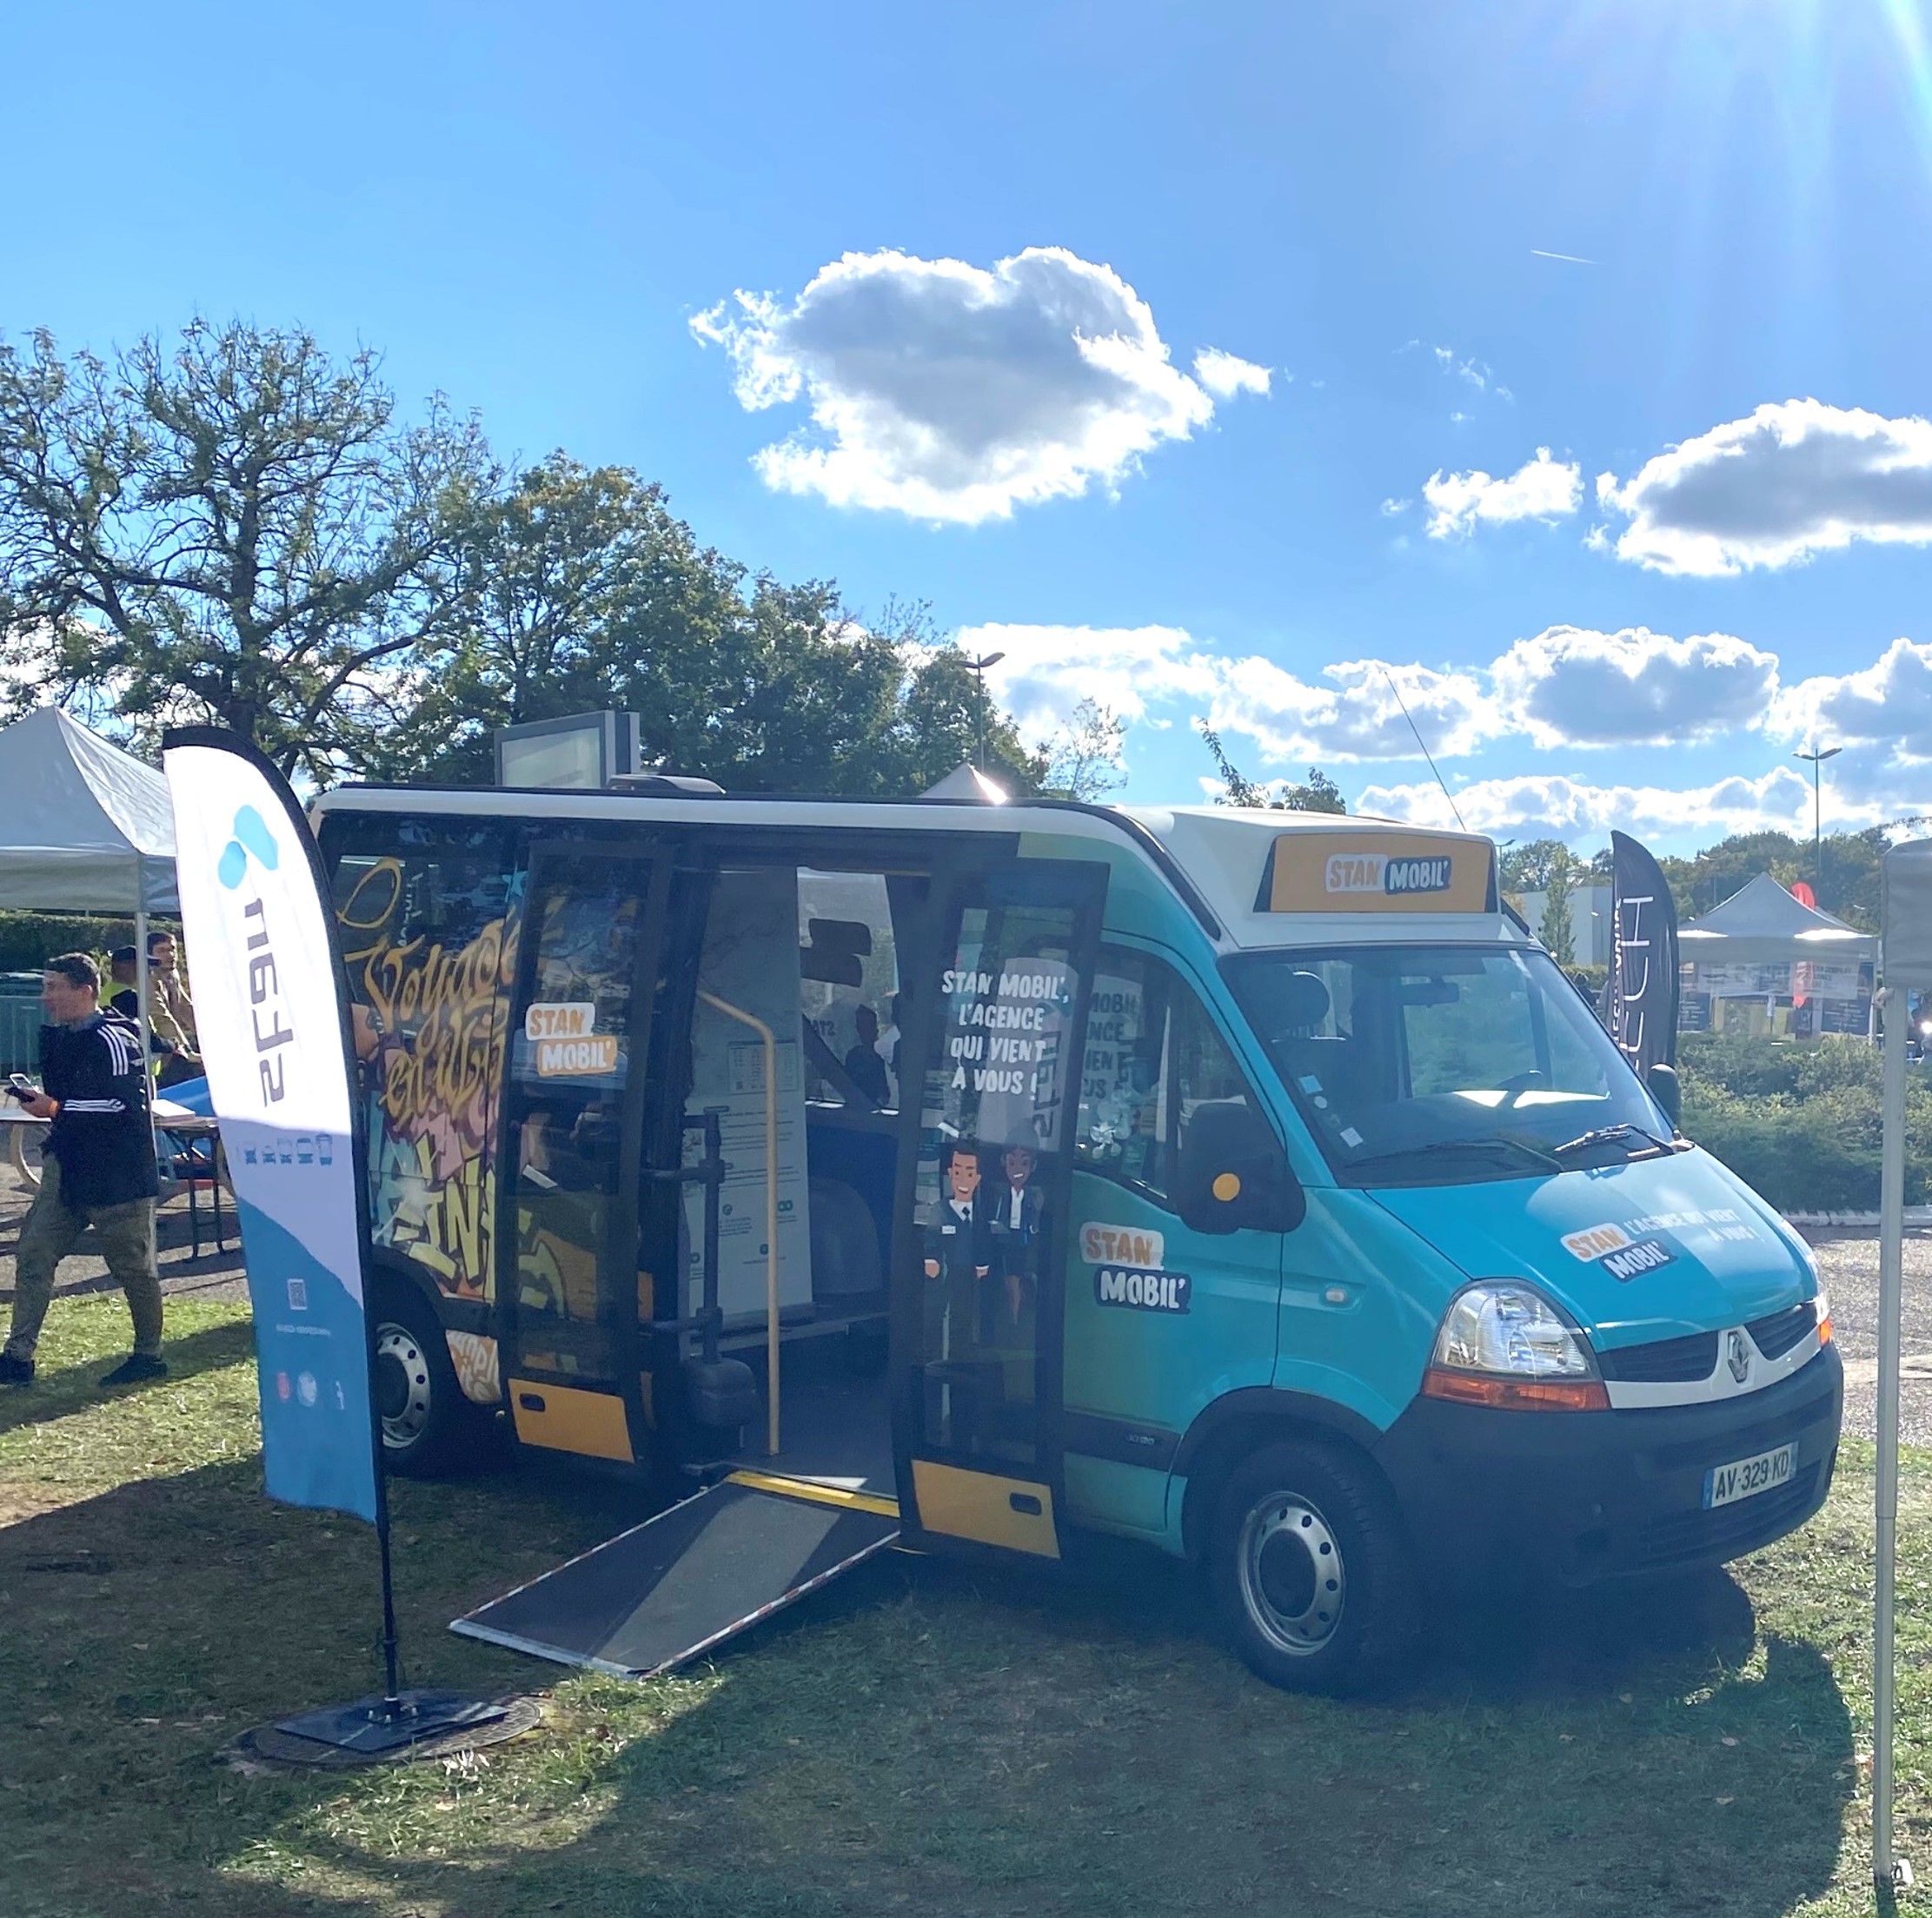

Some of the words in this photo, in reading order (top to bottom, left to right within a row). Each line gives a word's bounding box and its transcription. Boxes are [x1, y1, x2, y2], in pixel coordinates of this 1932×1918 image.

[1330, 860, 1382, 887] STAN
[1389, 859, 1449, 892] MOBIL'
[941, 970, 994, 995] STAN
[529, 1008, 585, 1036] STAN
[958, 1003, 1046, 1032] L'AGENCE
[541, 1039, 612, 1072] MOBIL'
[950, 1035, 983, 1064] QUI
[989, 1037, 1046, 1064] VIENT
[973, 1068, 1024, 1094] VOUS
[1086, 1228, 1153, 1266] STAN
[1566, 1227, 1625, 1259] STAN
[1603, 1240, 1670, 1279] MOBIL'
[1100, 1270, 1185, 1309] MOBIL'
